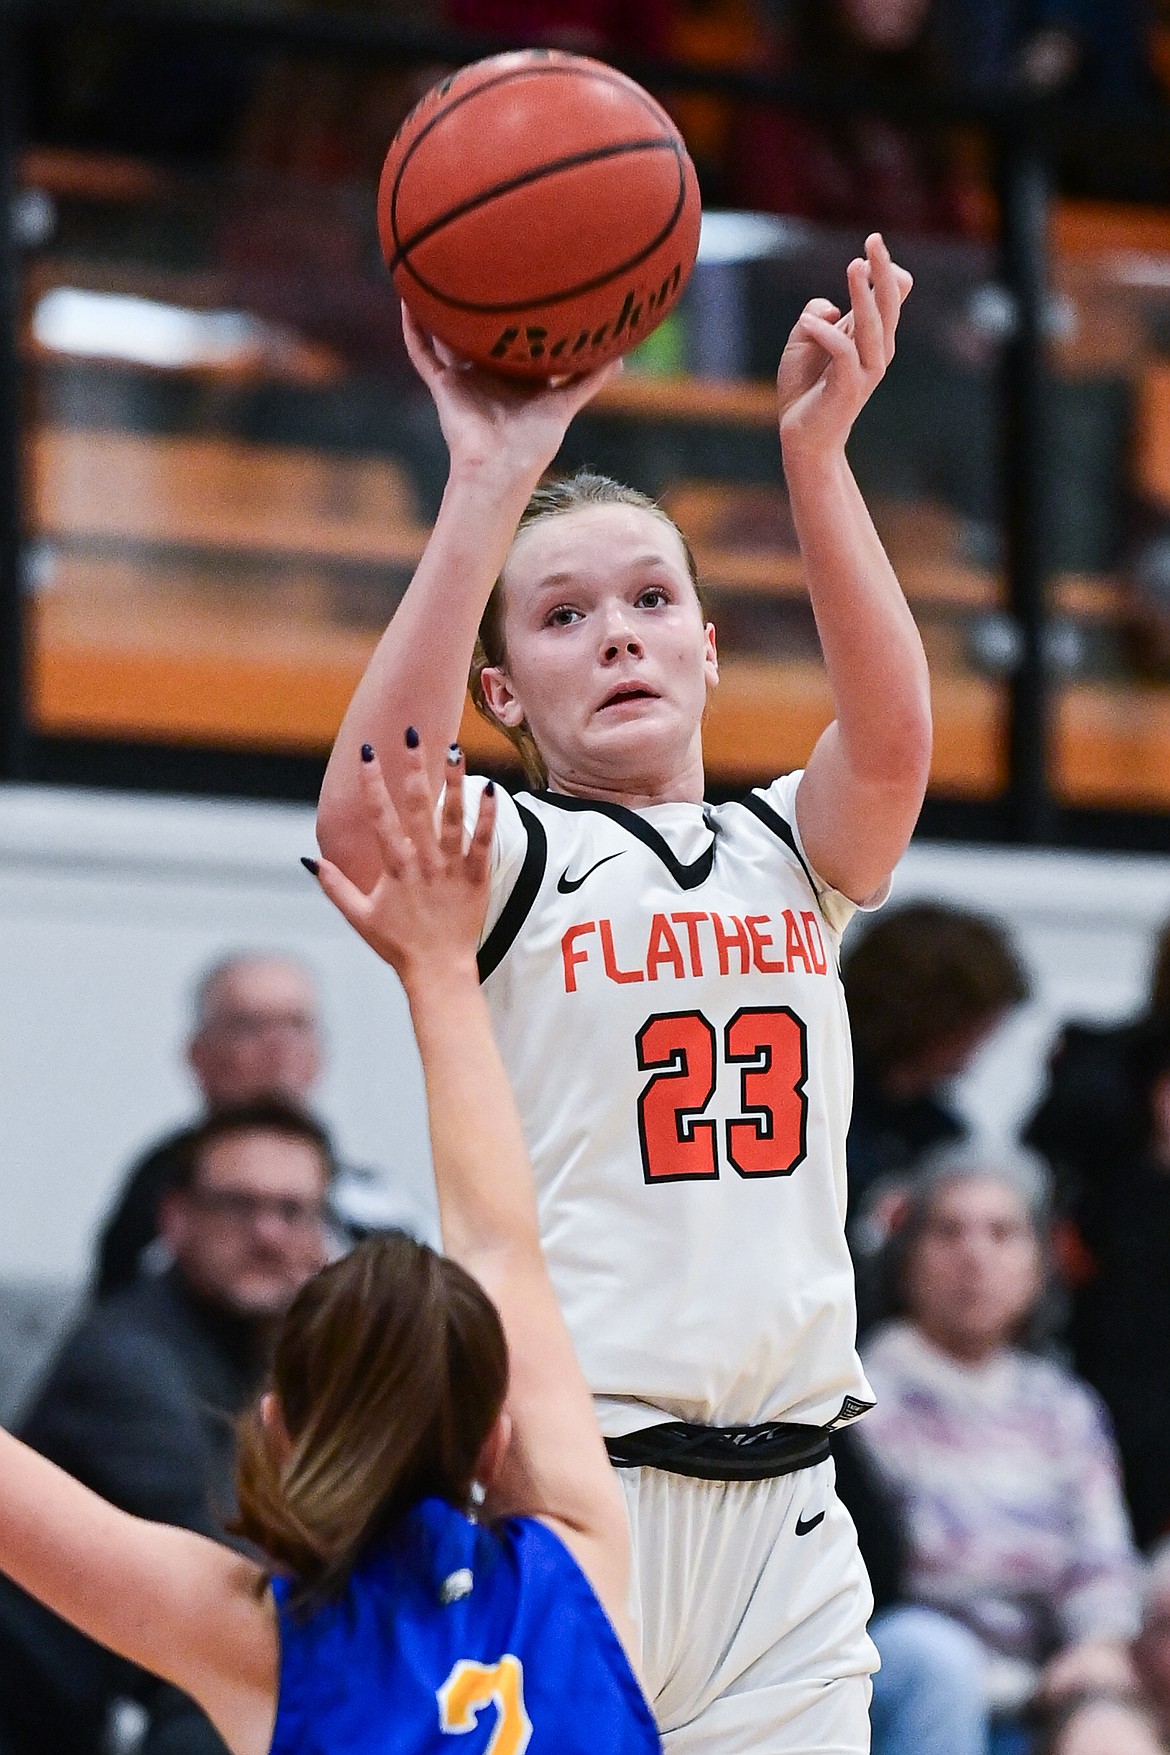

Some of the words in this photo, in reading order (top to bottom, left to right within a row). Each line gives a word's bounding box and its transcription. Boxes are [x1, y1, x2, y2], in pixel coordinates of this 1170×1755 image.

[489, 263, 681, 358] Baden
[560, 908, 827, 993] FLATHEAD
[635, 1005, 808, 1184] 23
